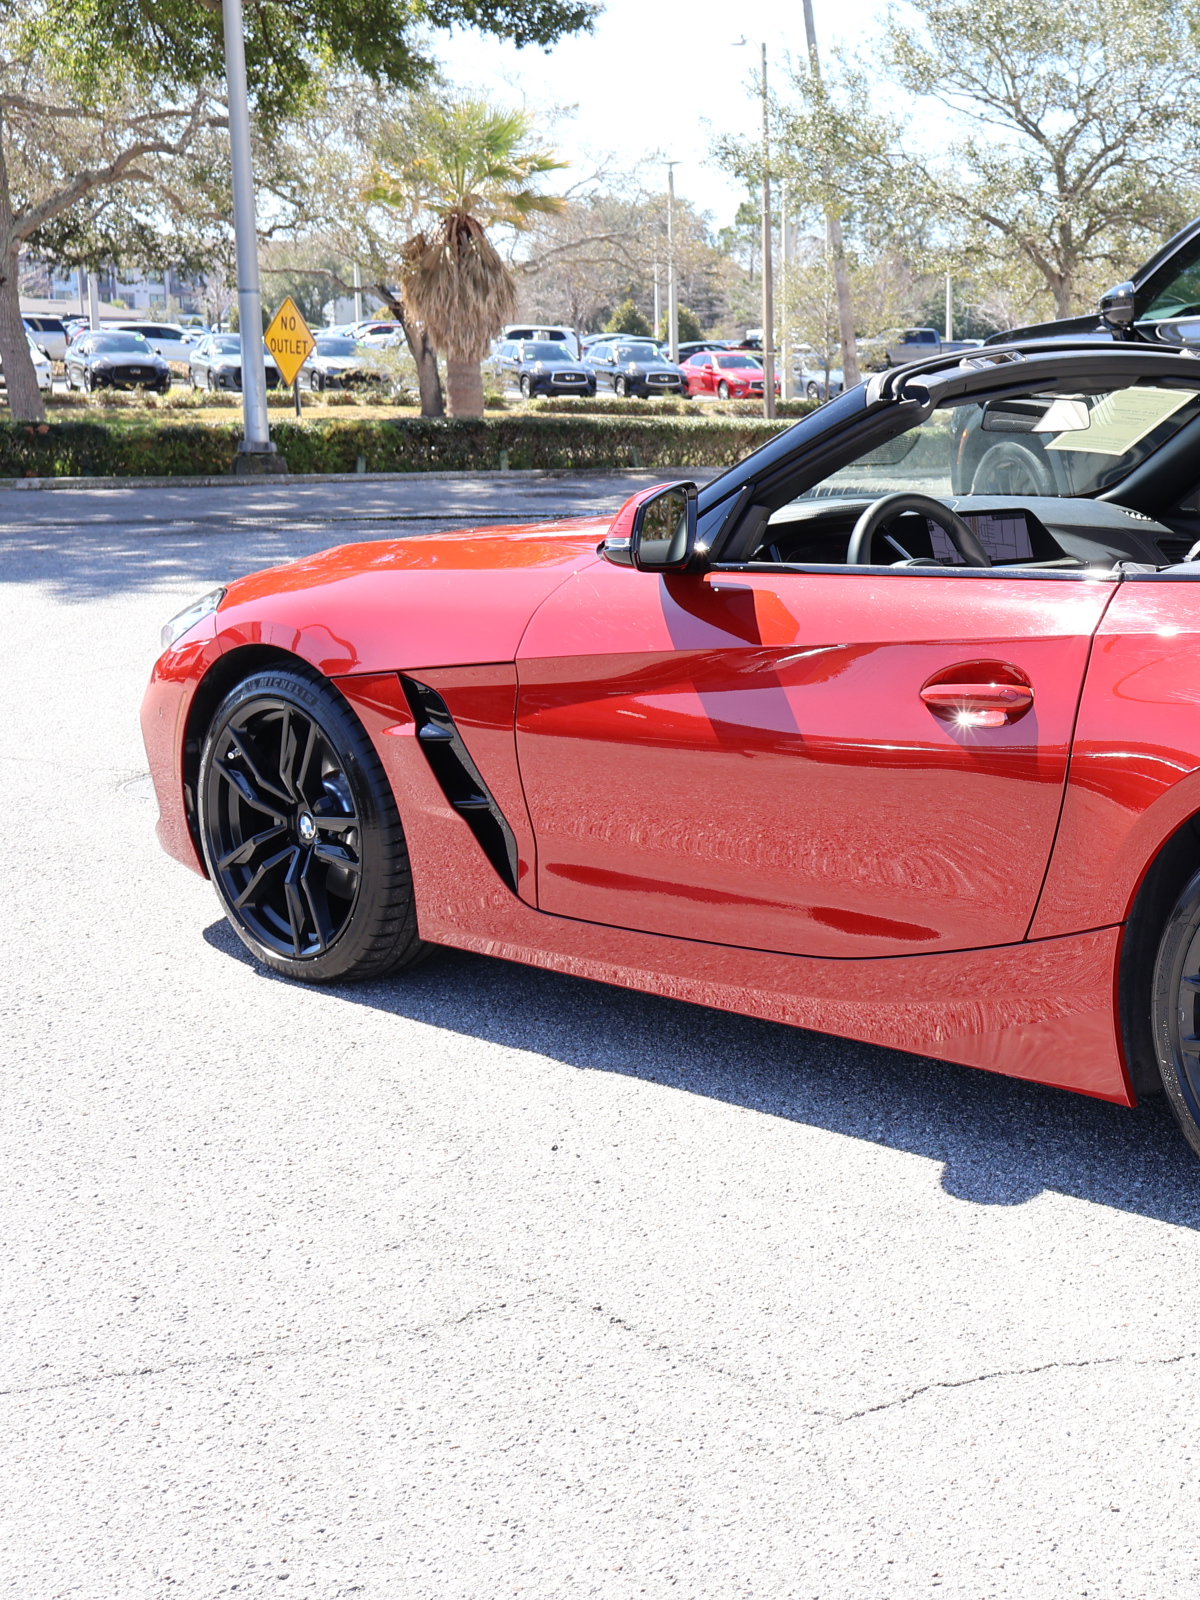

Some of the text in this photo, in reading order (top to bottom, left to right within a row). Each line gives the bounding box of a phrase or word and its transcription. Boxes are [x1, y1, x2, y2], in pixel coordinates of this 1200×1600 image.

[281, 316, 296, 331] NO
[270, 338, 308, 354] OUTLET
[258, 678, 315, 703] MICHELIN
